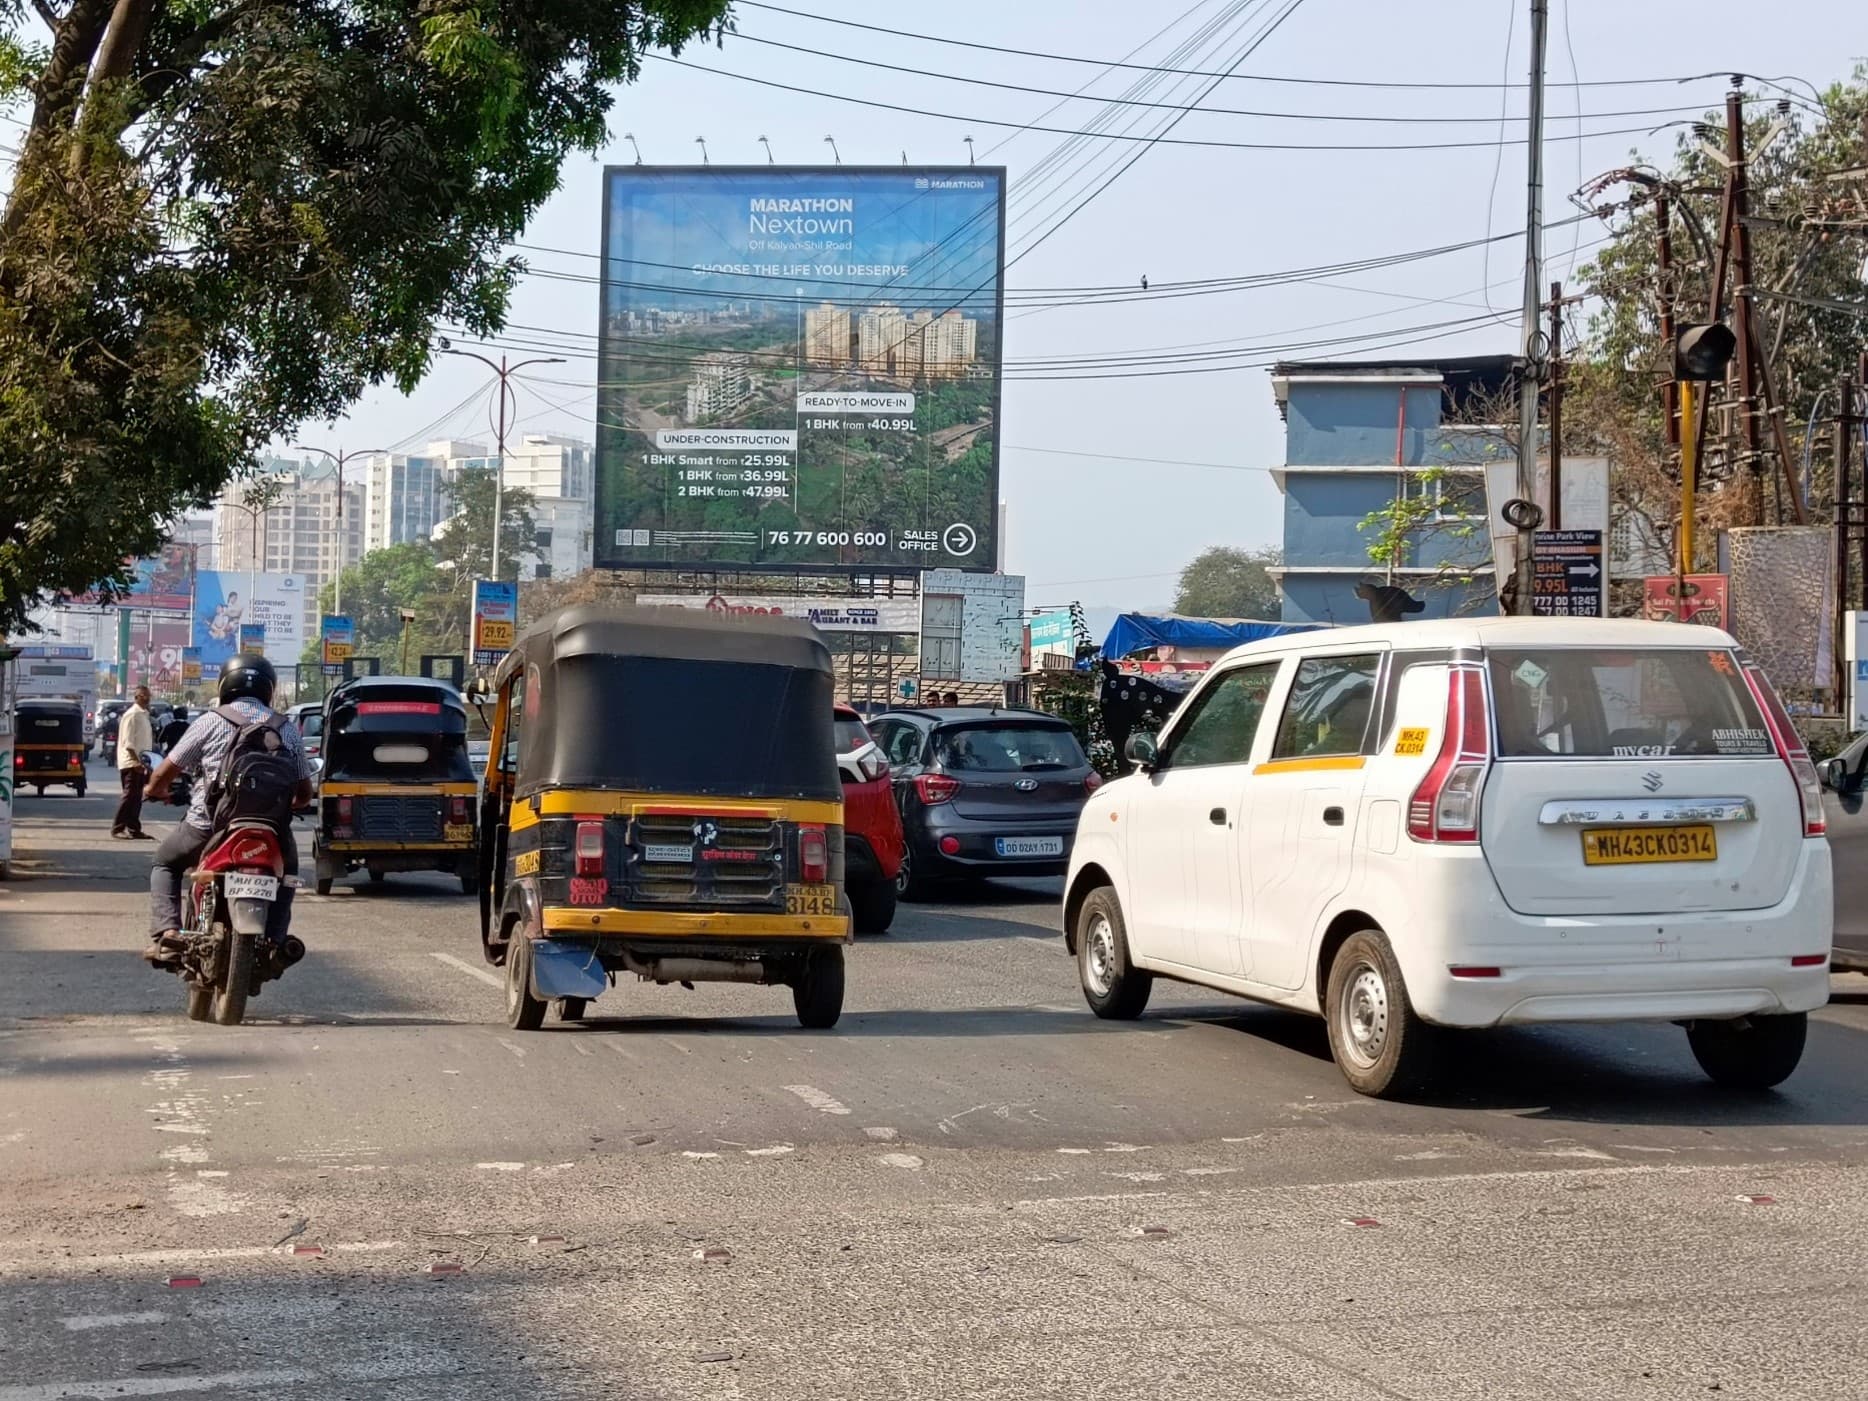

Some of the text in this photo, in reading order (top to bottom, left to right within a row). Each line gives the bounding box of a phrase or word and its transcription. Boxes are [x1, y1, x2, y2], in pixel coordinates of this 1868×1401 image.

[931, 180, 984, 189] MARATHON
[750, 199, 853, 212] MARATHON
[750, 214, 853, 234] Nextown
[749, 240, 852, 251] Off Kalyan-Shil Road
[693, 264, 909, 276] CHOOSE THE LIFE YOU DESERVE
[805, 397, 907, 407] READY-TO-MOVE-IN
[805, 419, 811, 429] 1
[813, 419, 840, 430] BHK
[842, 421, 865, 430] from
[663, 434, 790, 445] UNDER-CONSTRUCTION
[641, 454, 648, 464] 1
[650, 454, 676, 465] BHK
[679, 455, 713, 466] Smart
[716, 456, 738, 466] from
[678, 470, 684, 480] 1
[686, 470, 713, 481] BHK
[715, 471, 737, 481] from
[678, 486, 686, 496] 2
[688, 486, 715, 497] BHK
[717, 487, 740, 497] from
[769, 531, 789, 545] 76
[793, 531, 813, 545] 77
[816, 531, 850, 546] 600
[853, 532, 886, 546] 600
[904, 530, 938, 540] SALES
[898, 540, 938, 551] OFFICE
[1536, 563, 1564, 572] BHK
[1534, 580, 1568, 592] 9.95L
[1572, 595, 1597, 605] 1245
[1572, 606, 1597, 616] 1247
[1712, 729, 1767, 740] ABHISHEK
[1598, 833, 1711, 857] MH43CK0314
